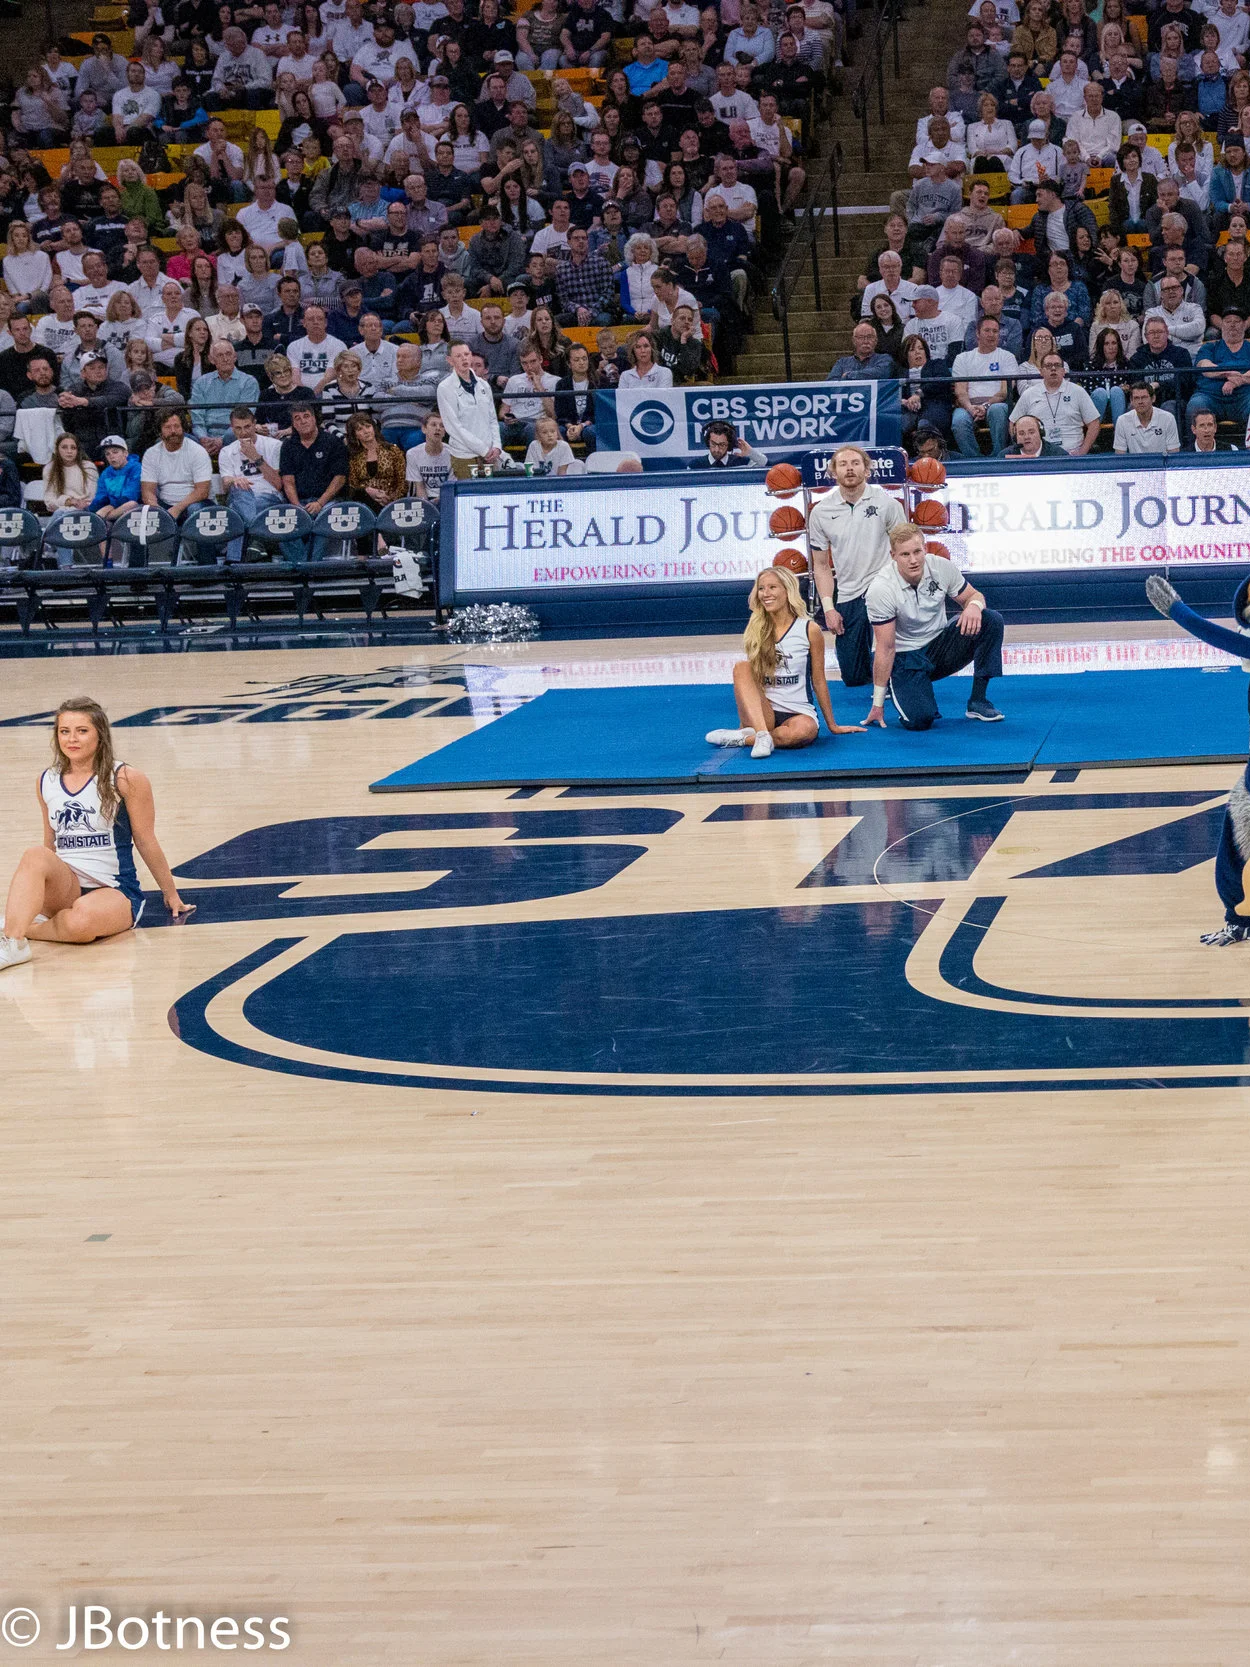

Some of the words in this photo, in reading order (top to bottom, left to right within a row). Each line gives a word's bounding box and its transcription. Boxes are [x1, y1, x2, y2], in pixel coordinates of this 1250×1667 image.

[299, 359, 329, 368] STATE
[692, 396, 748, 420] CBS
[754, 392, 865, 418] SPORTS
[694, 415, 838, 443] TWORK
[420, 466, 433, 474] UTAH
[434, 465, 448, 473] STATE
[964, 482, 1000, 498] THE
[527, 498, 564, 514] THE
[473, 505, 667, 552] HERALD
[971, 546, 1094, 566] EMPOWERING
[1098, 545, 1136, 562] THE
[533, 563, 657, 583] EMPOWERING
[660, 561, 697, 576] THE
[774, 674, 800, 684] STATE
[57, 835, 76, 850] UTAH
[76, 833, 111, 848] STATE
